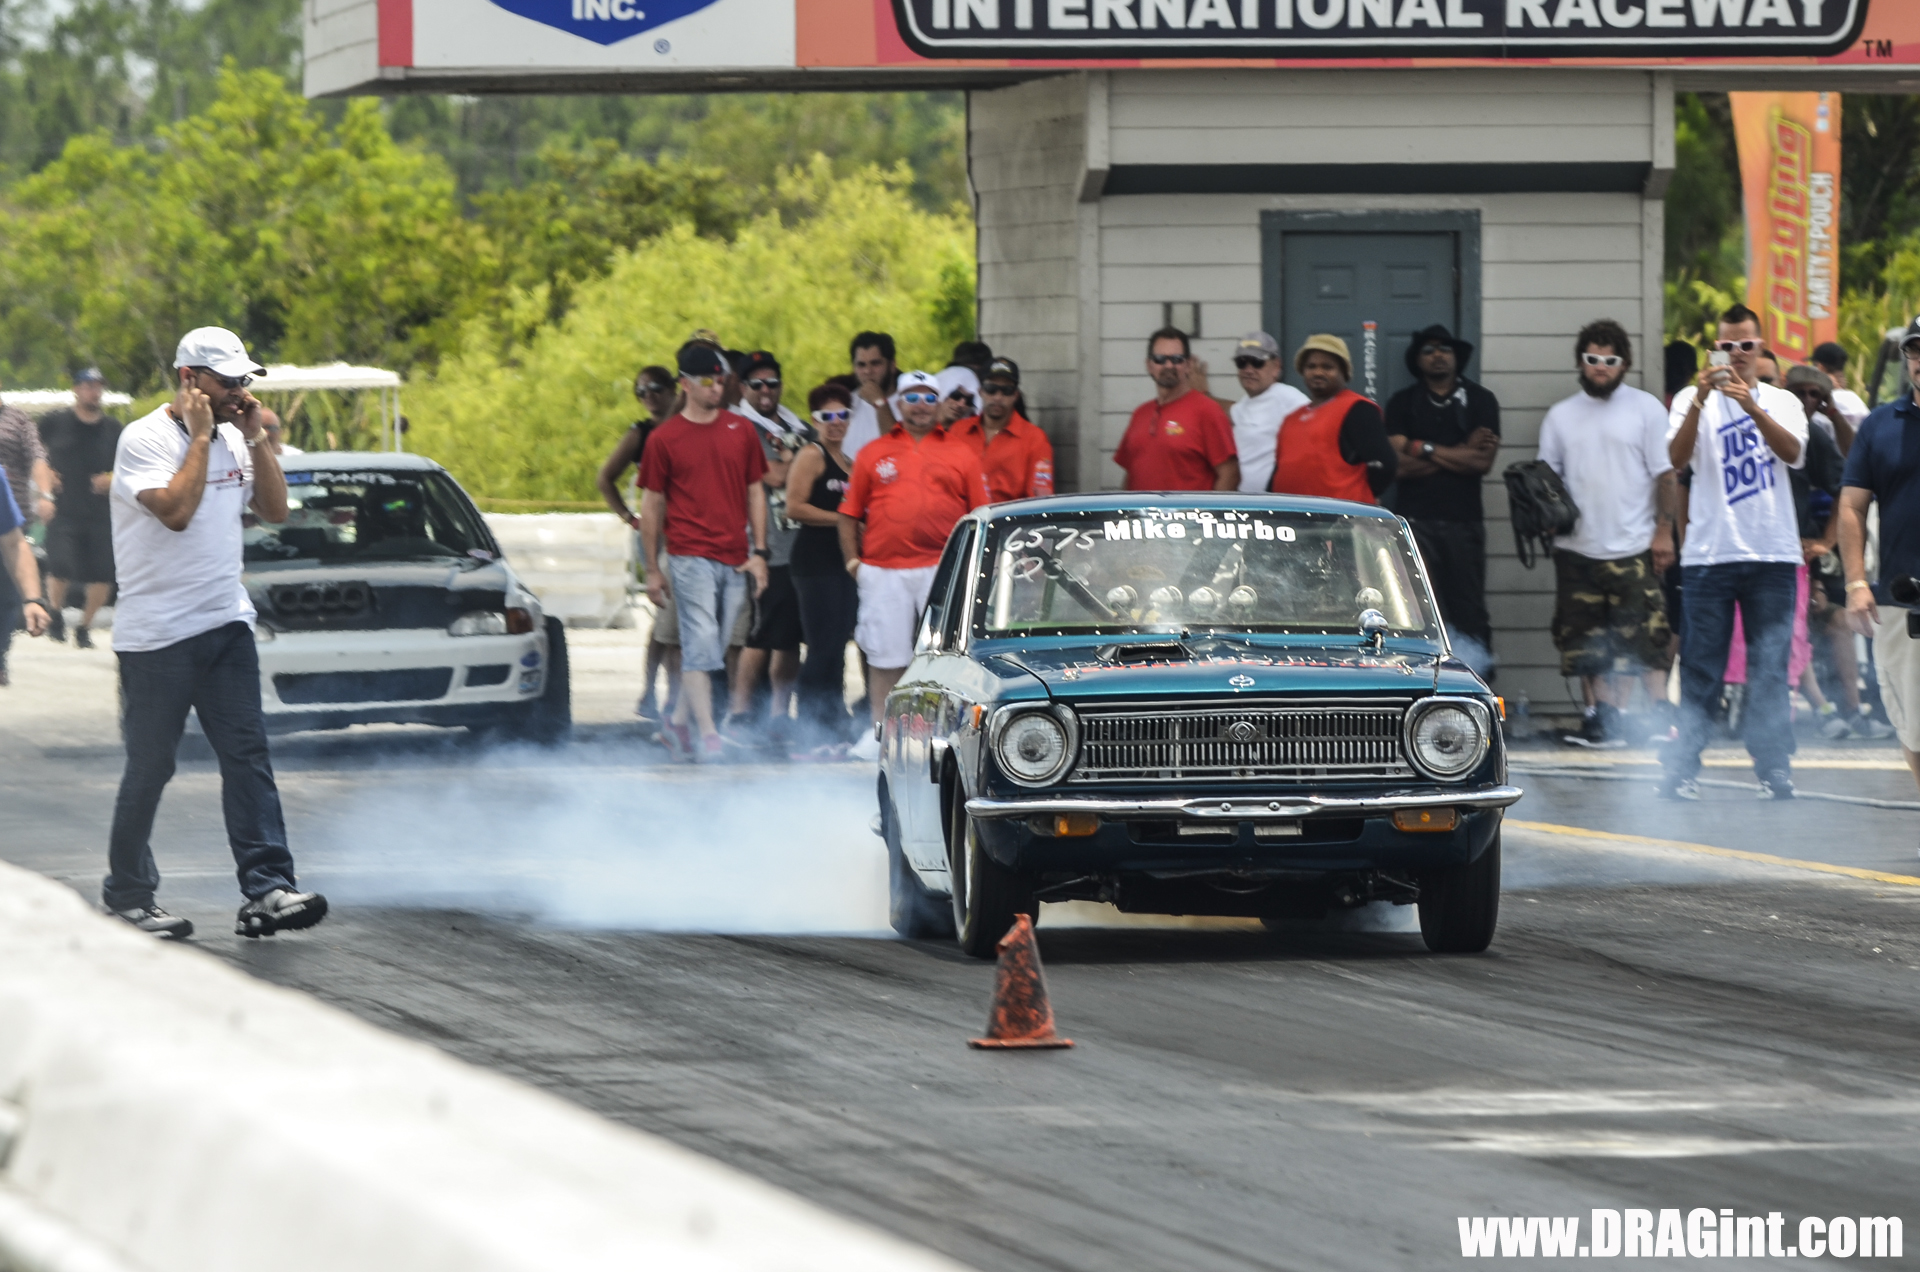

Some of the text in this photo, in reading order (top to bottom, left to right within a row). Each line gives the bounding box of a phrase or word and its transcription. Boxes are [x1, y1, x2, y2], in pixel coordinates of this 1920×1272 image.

[572, 0, 646, 21] INC.
[931, 0, 1827, 29] INTERNATIONAL RACEWAY
[1863, 39, 1893, 58] TM
[1809, 172, 1834, 239] POUCH
[1807, 254, 1832, 319] PARTY
[1722, 422, 1760, 464] JUS
[1724, 456, 1757, 494] DO
[1103, 518, 1297, 542] Mike Turbo
[1148, 511, 1250, 521] TURBO BY
